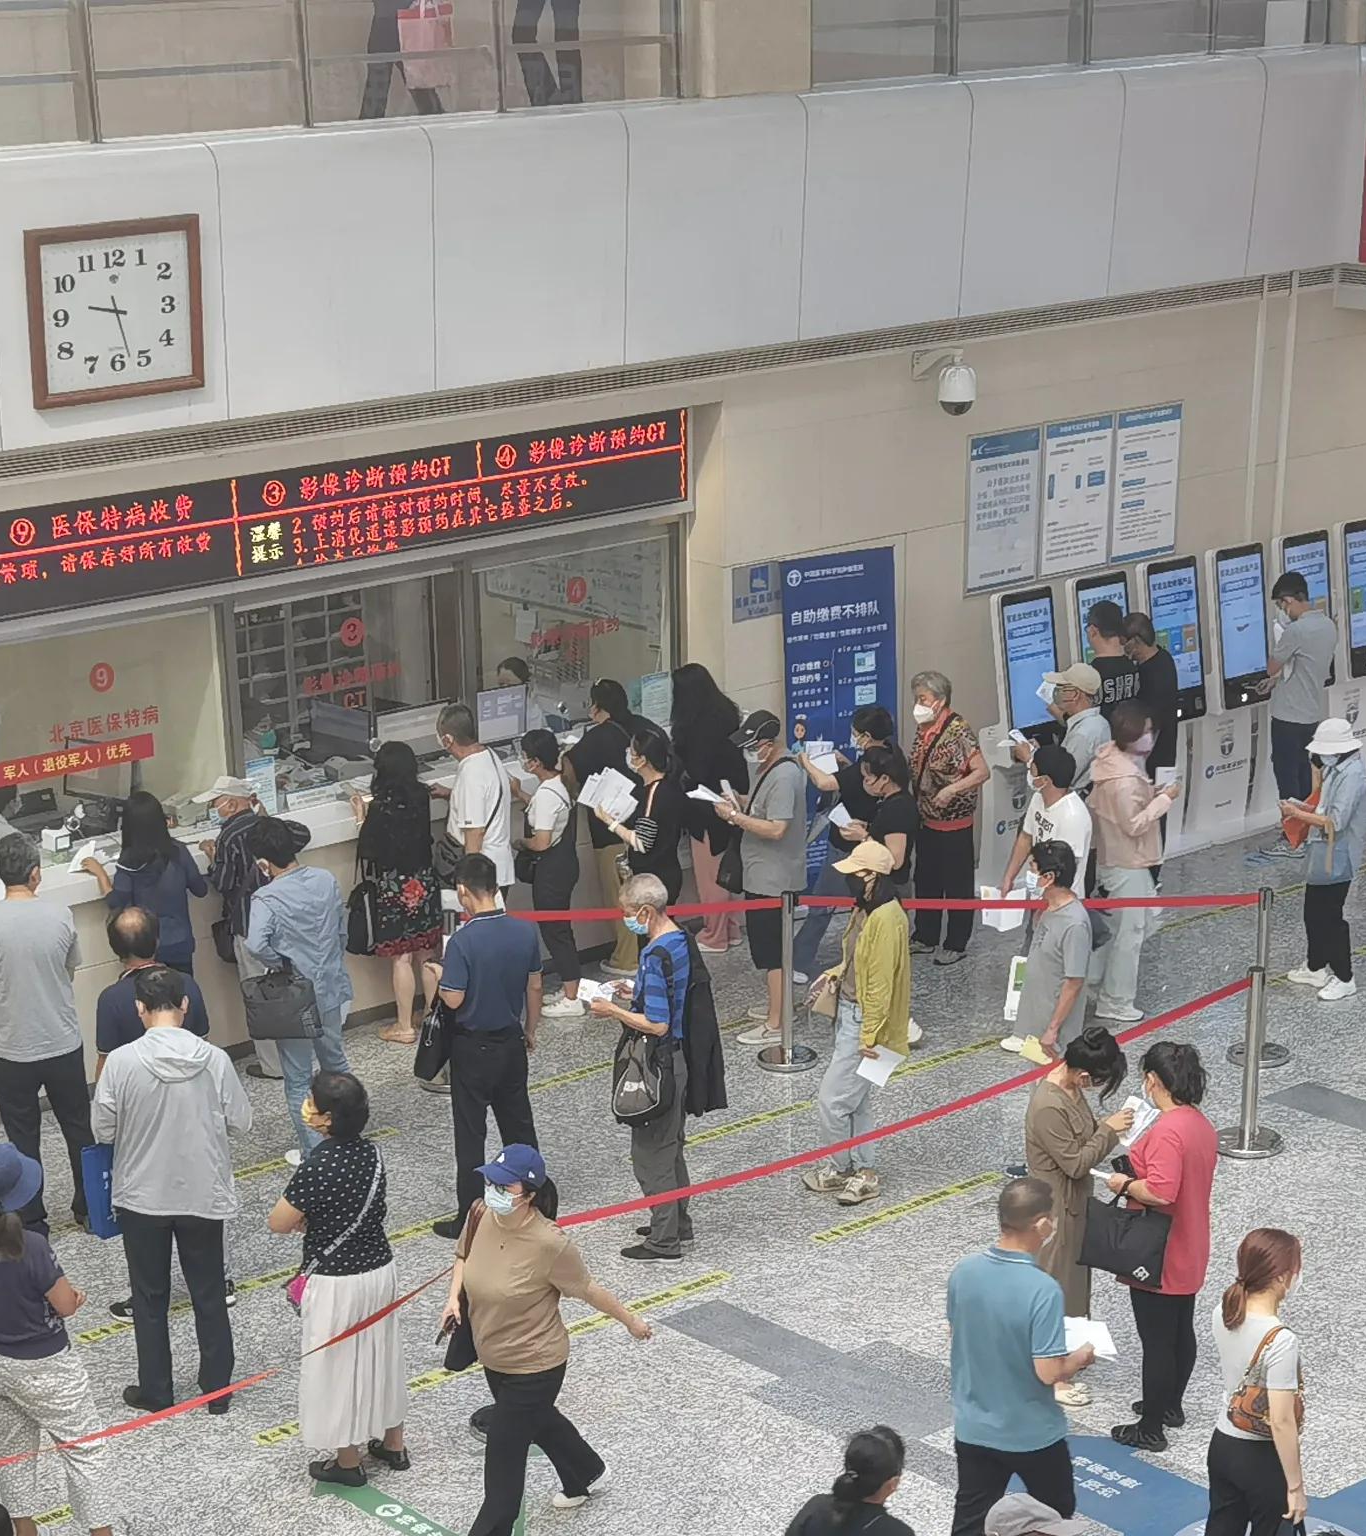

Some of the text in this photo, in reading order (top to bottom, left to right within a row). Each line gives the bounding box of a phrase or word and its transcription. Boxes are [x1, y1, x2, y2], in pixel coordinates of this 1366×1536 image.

[77, 255, 96, 273] 11
[103, 249, 126, 269] 12
[135, 248, 147, 266] 1
[156, 262, 173, 281] 2
[54, 274, 75, 294] 10
[160, 295, 176, 314] 3
[52, 309, 70, 328] 9
[159, 329, 175, 346] 4
[57, 342, 74, 360] 8
[136, 349, 152, 367] 5
[84, 355, 99, 374] 7
[110, 354, 126, 372] 6
[529, 421, 667, 465] 影像诊断预约CT
[299, 456, 452, 501] 影像诊断预约CT
[51, 494, 194, 540] 医保特病收费
[791, 600, 880, 626] 自助缴费不排队
[49, 705, 160, 743] 北京医保特病
[3, 744, 132, 781] 军人（退役军人）优先
